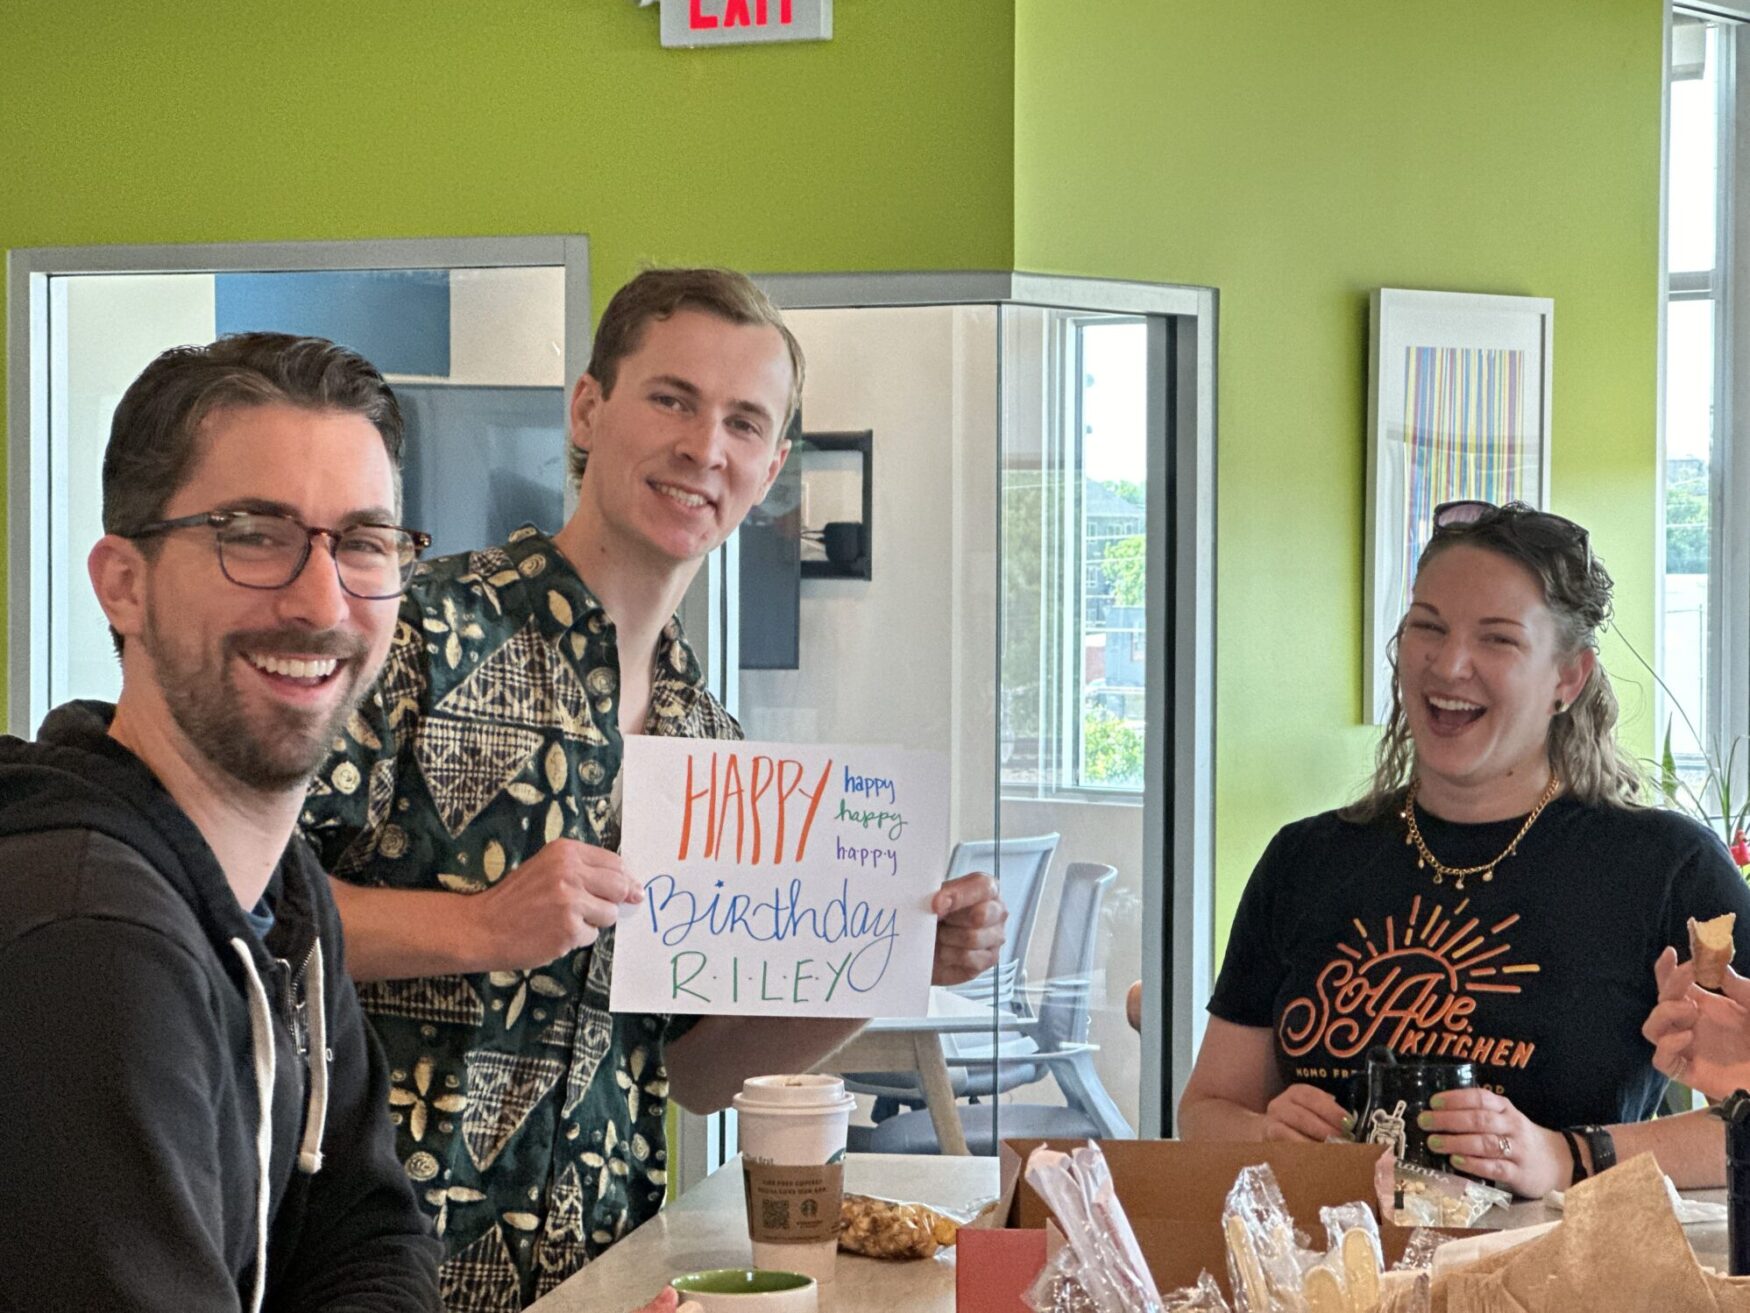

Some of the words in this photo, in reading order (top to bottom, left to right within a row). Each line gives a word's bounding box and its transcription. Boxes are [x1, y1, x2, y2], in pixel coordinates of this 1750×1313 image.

[844, 765, 896, 804] happy
[677, 752, 833, 865] HAPPY
[834, 798, 908, 841] happy
[1399, 1029, 1535, 1069] KITCHEN
